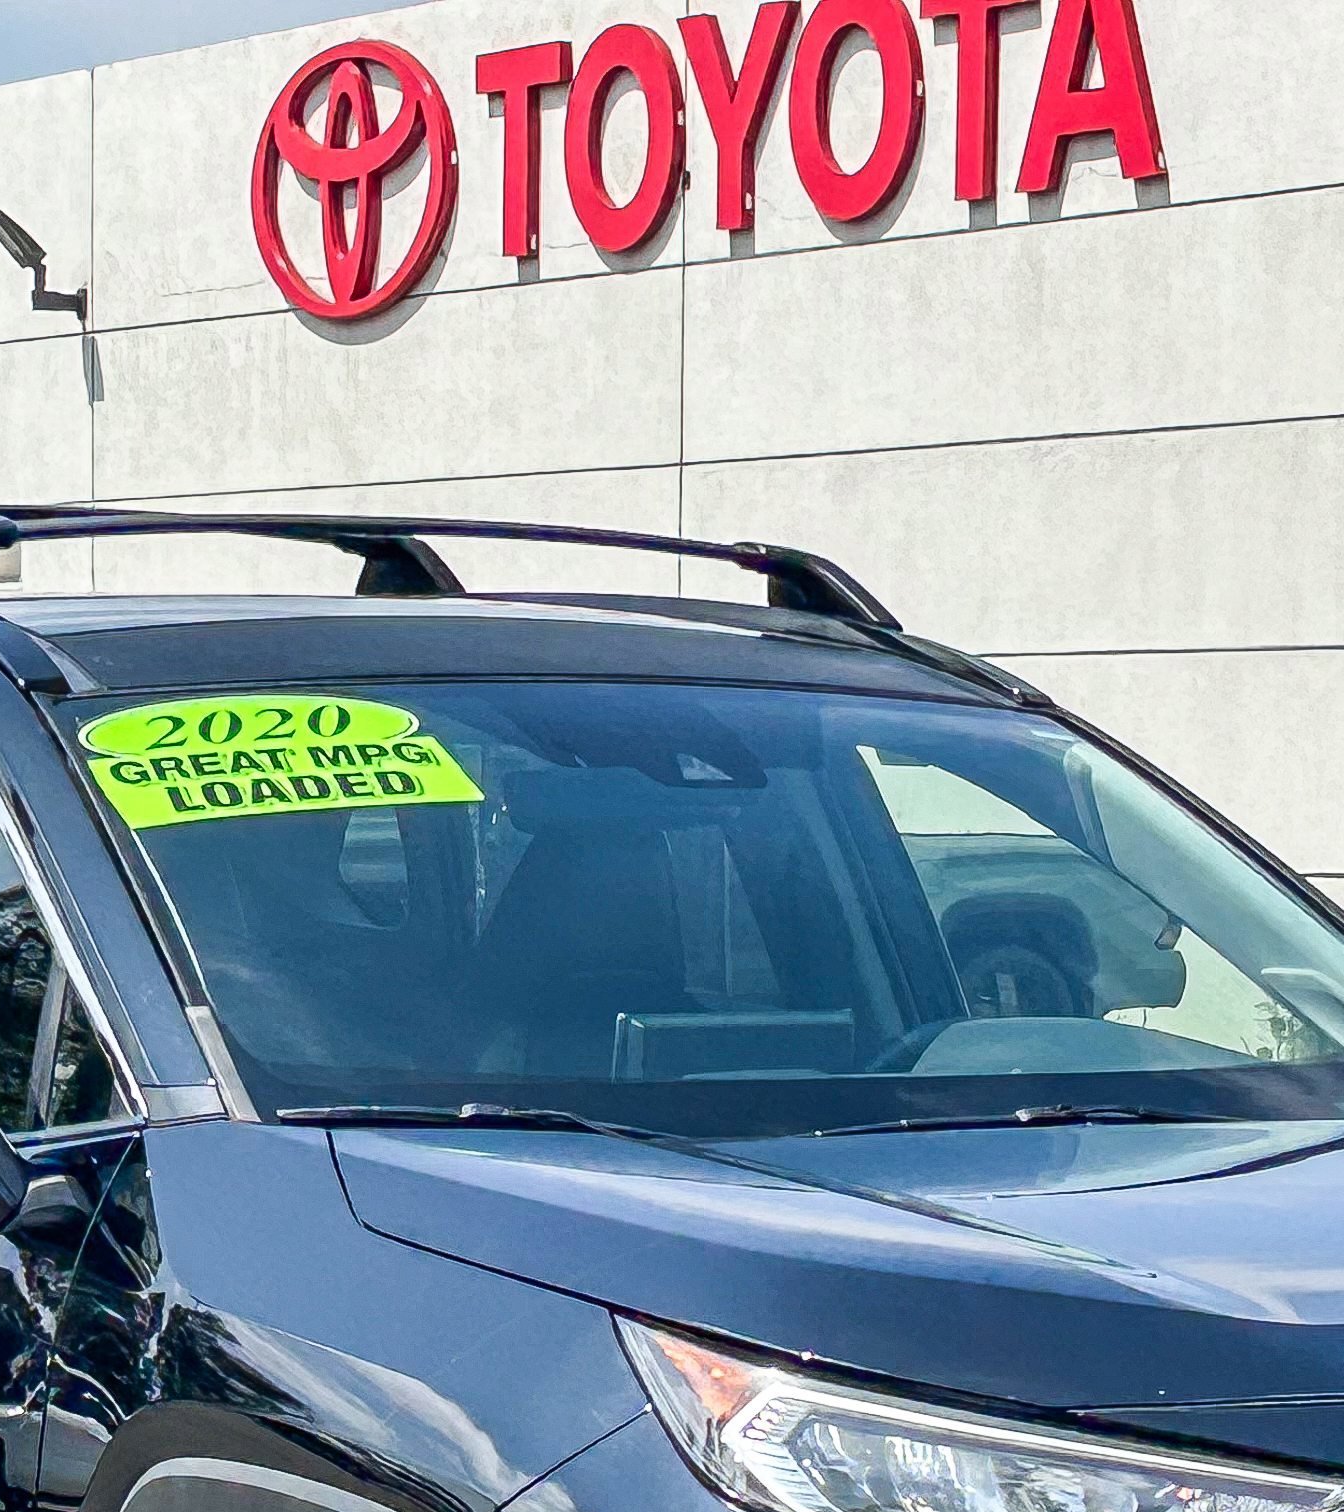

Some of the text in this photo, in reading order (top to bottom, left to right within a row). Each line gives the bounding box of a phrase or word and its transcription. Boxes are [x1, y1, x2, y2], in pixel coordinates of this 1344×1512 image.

[475, 0, 1165, 258] TOYOTA
[145, 703, 352, 751] 2020
[109, 742, 433, 785] GREAT MPG
[164, 770, 419, 812] LOADED
